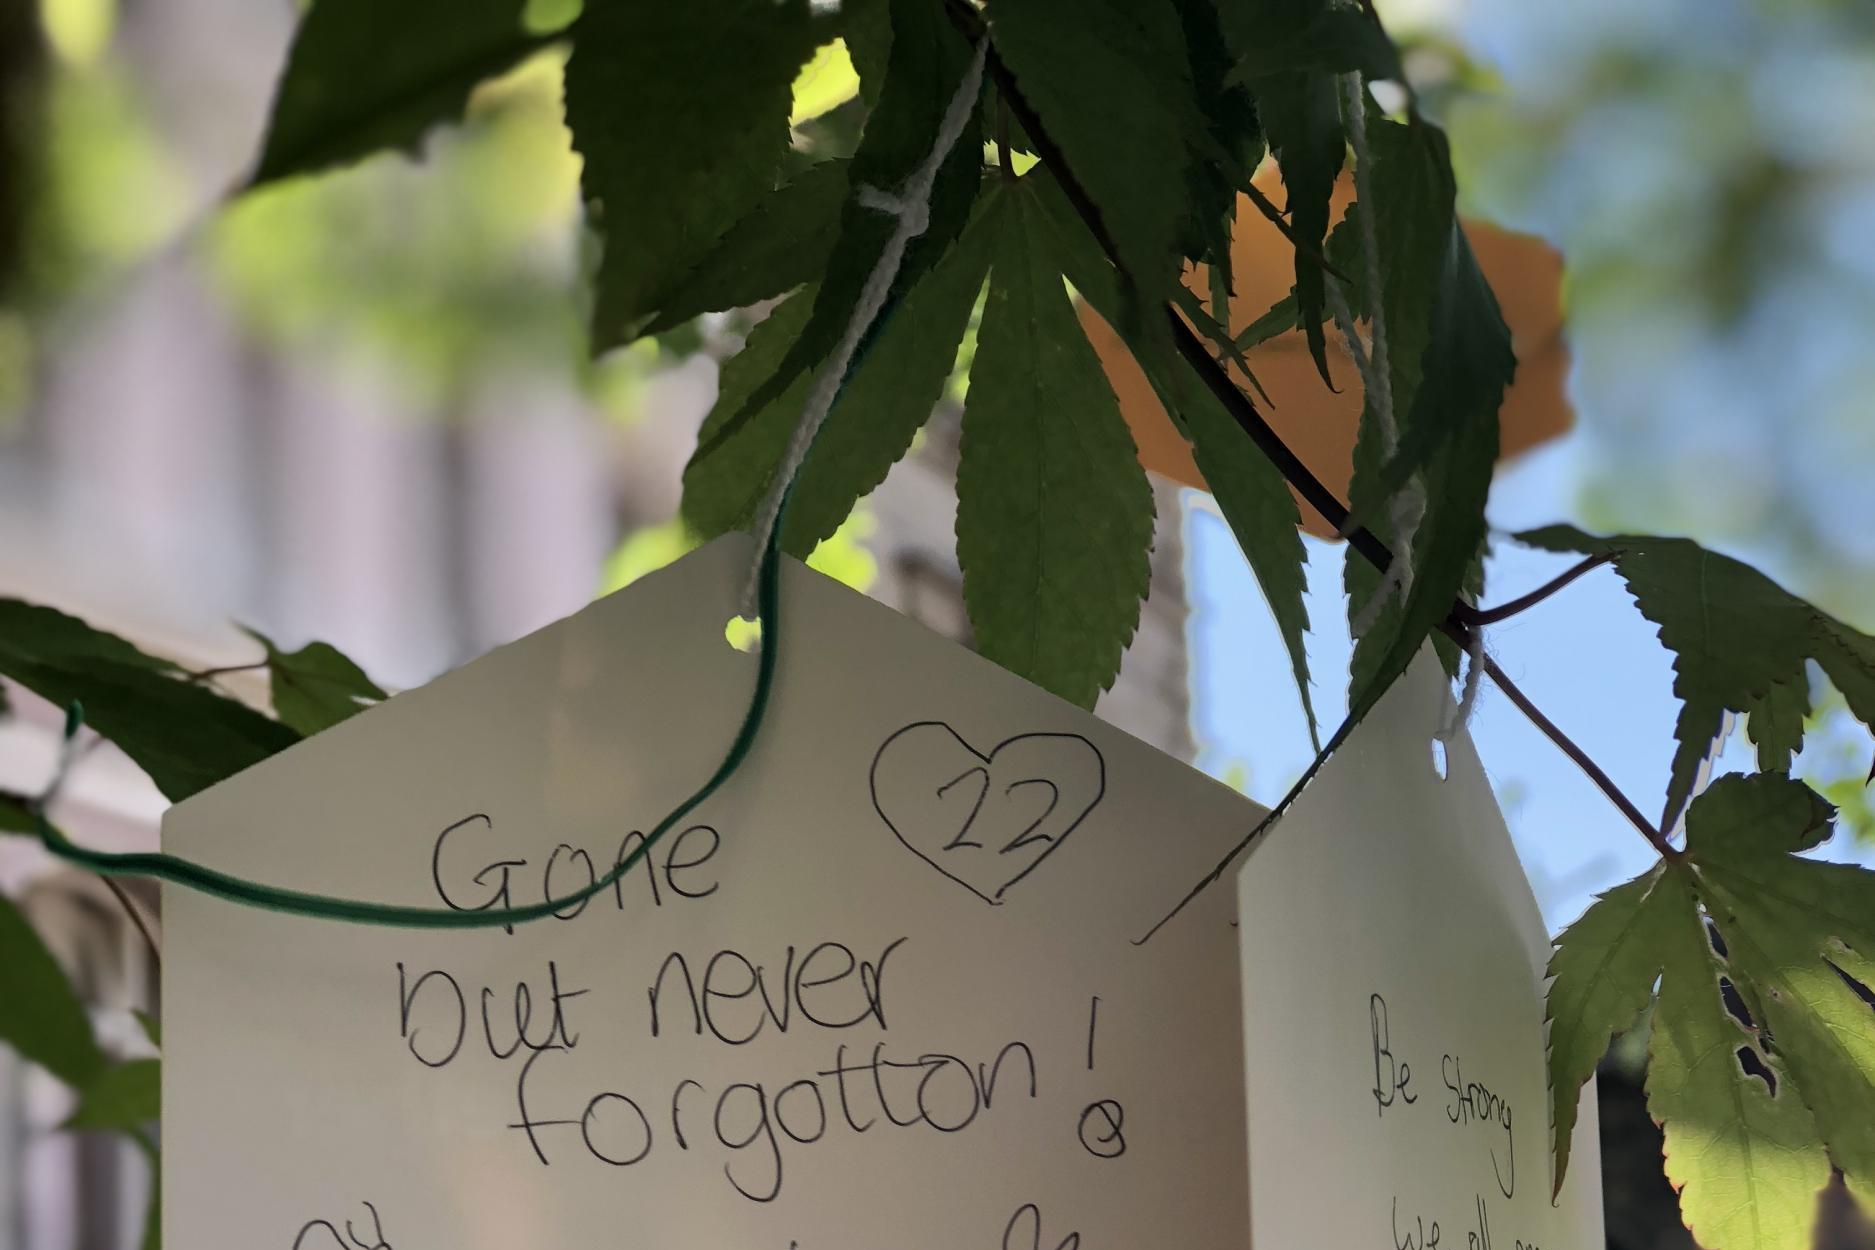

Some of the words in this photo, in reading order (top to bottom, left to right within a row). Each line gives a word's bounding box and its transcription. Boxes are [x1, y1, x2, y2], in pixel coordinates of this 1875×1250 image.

[937, 766, 1059, 855] 22
[432, 813, 720, 935] Gone
[396, 960, 590, 1067] but
[648, 936, 908, 1044] never
[1369, 993, 1419, 1118] Be
